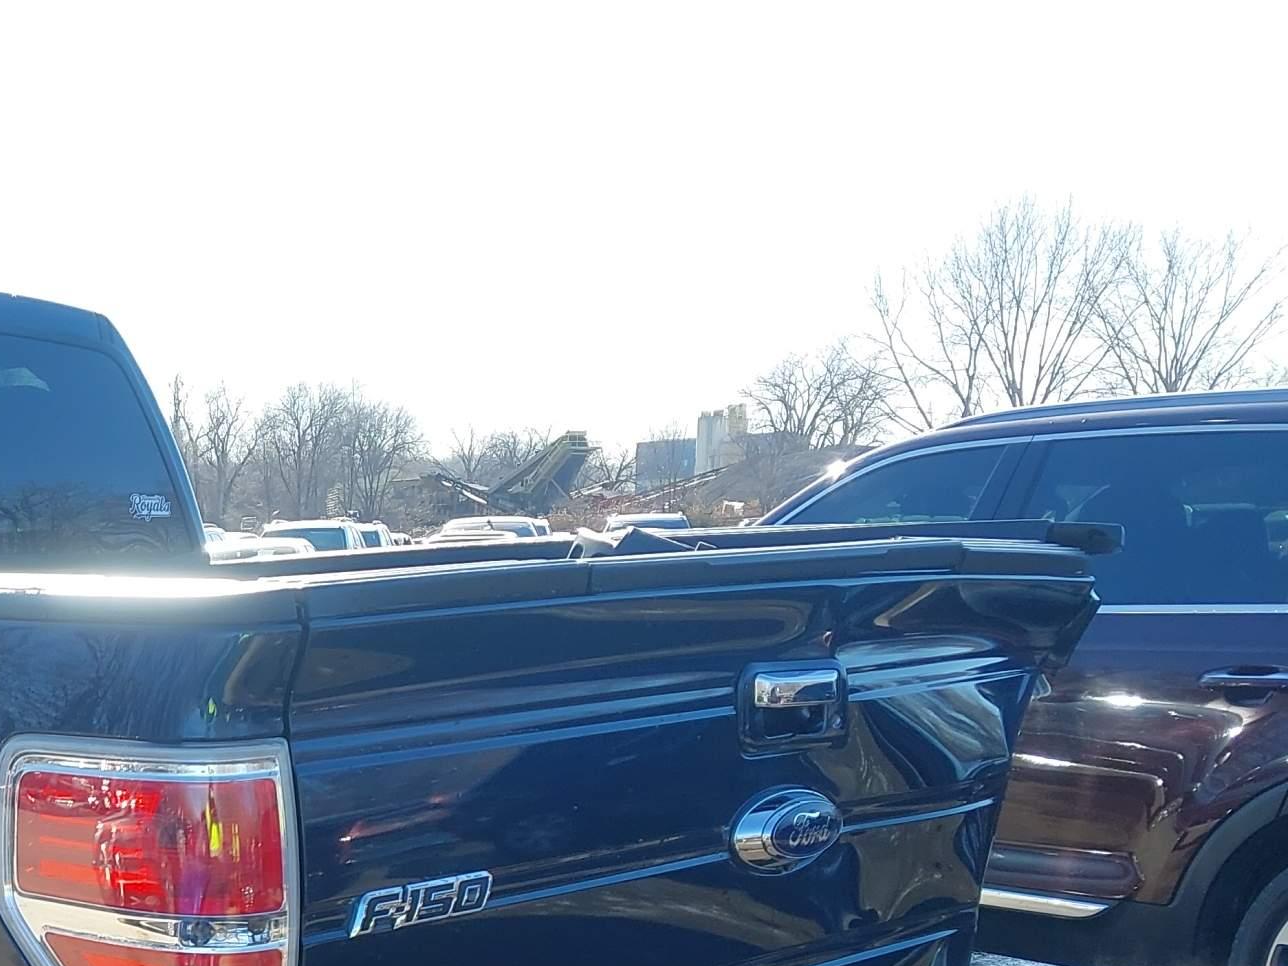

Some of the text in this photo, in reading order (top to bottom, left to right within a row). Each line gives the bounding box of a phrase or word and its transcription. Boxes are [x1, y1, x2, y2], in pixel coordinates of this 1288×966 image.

[129, 493, 171, 522] Royals
[789, 811, 831, 847] Ford
[349, 870, 493, 939] F-150
